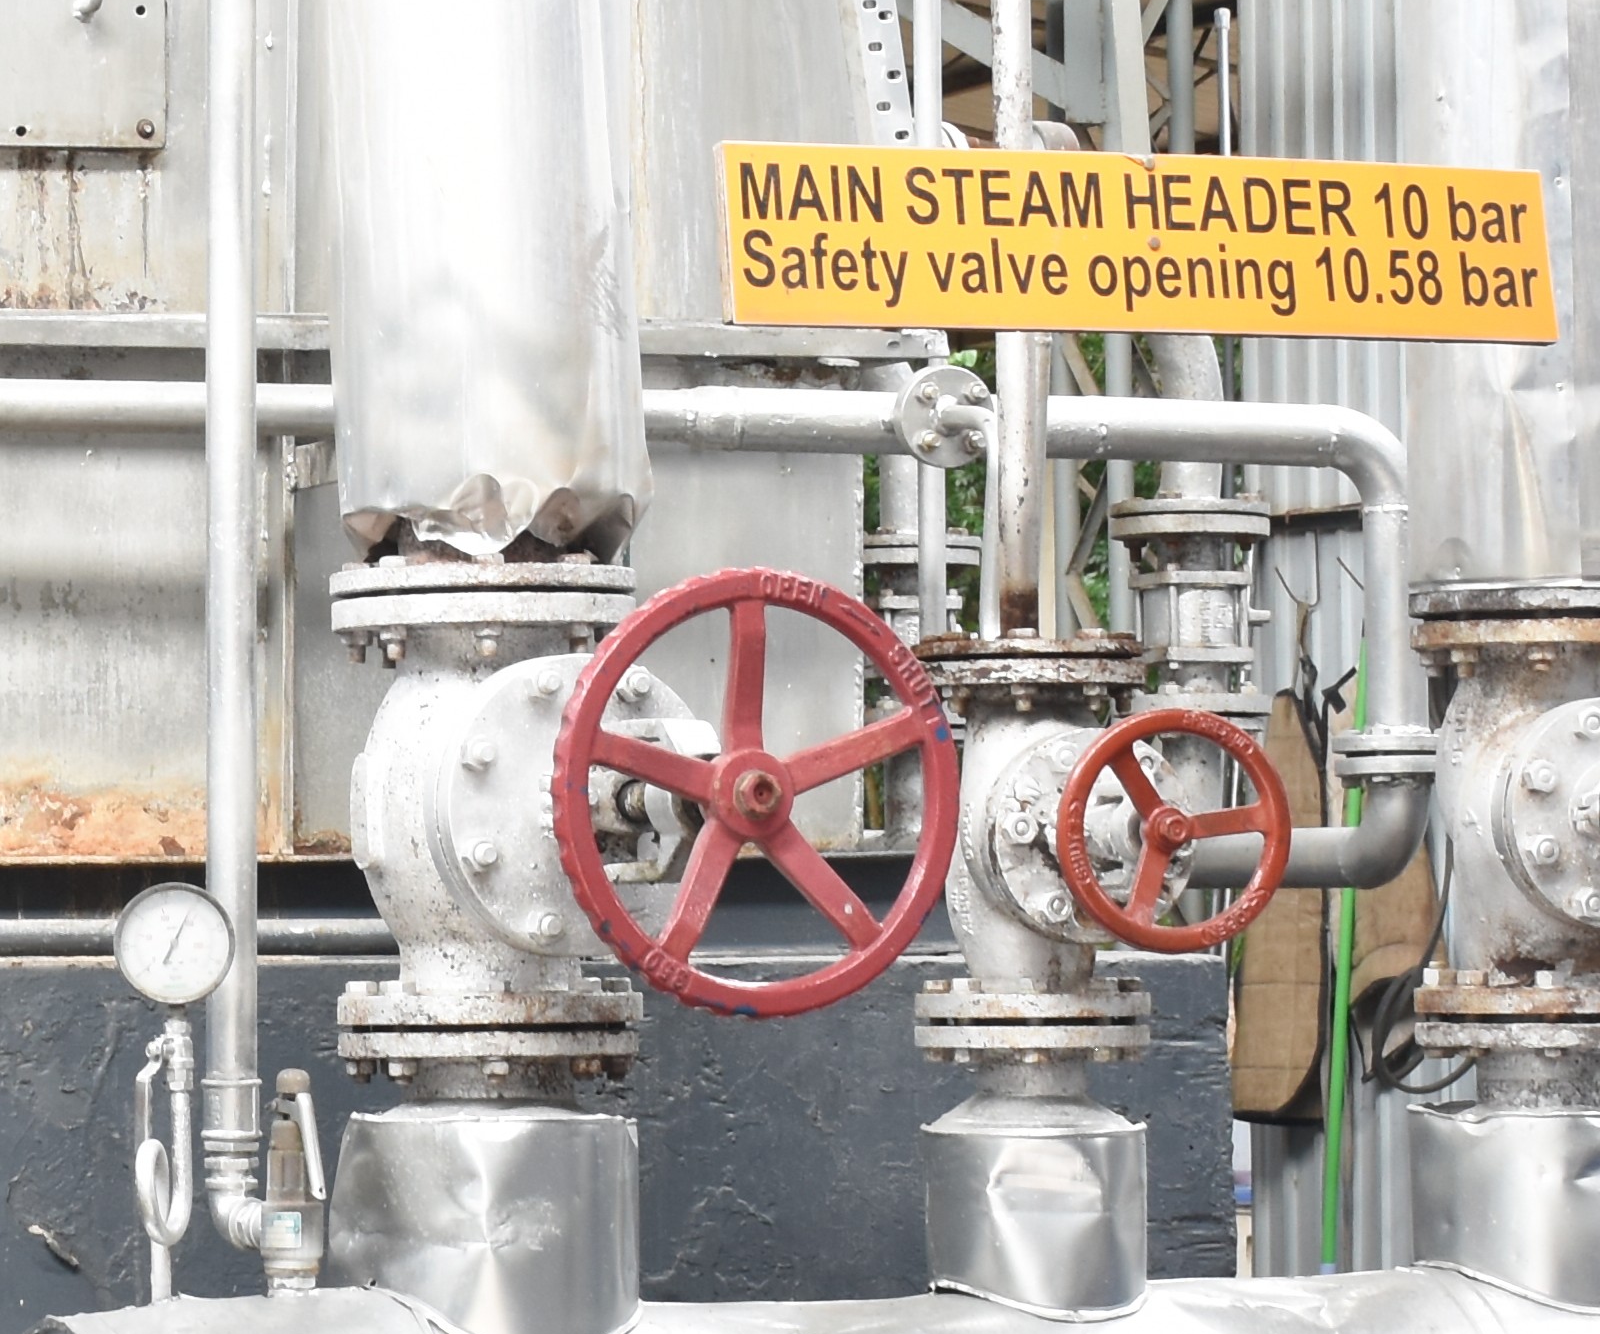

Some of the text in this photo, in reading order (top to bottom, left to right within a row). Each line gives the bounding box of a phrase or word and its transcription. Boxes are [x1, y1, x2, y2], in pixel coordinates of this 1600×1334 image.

[740, 162, 1527, 243] MAIN STEAM HEADER 10 bar
[743, 229, 1538, 317] Safety valve opening 10.58 bar
[759, 570, 829, 609] OPEN
[888, 641, 939, 708] SHUT
